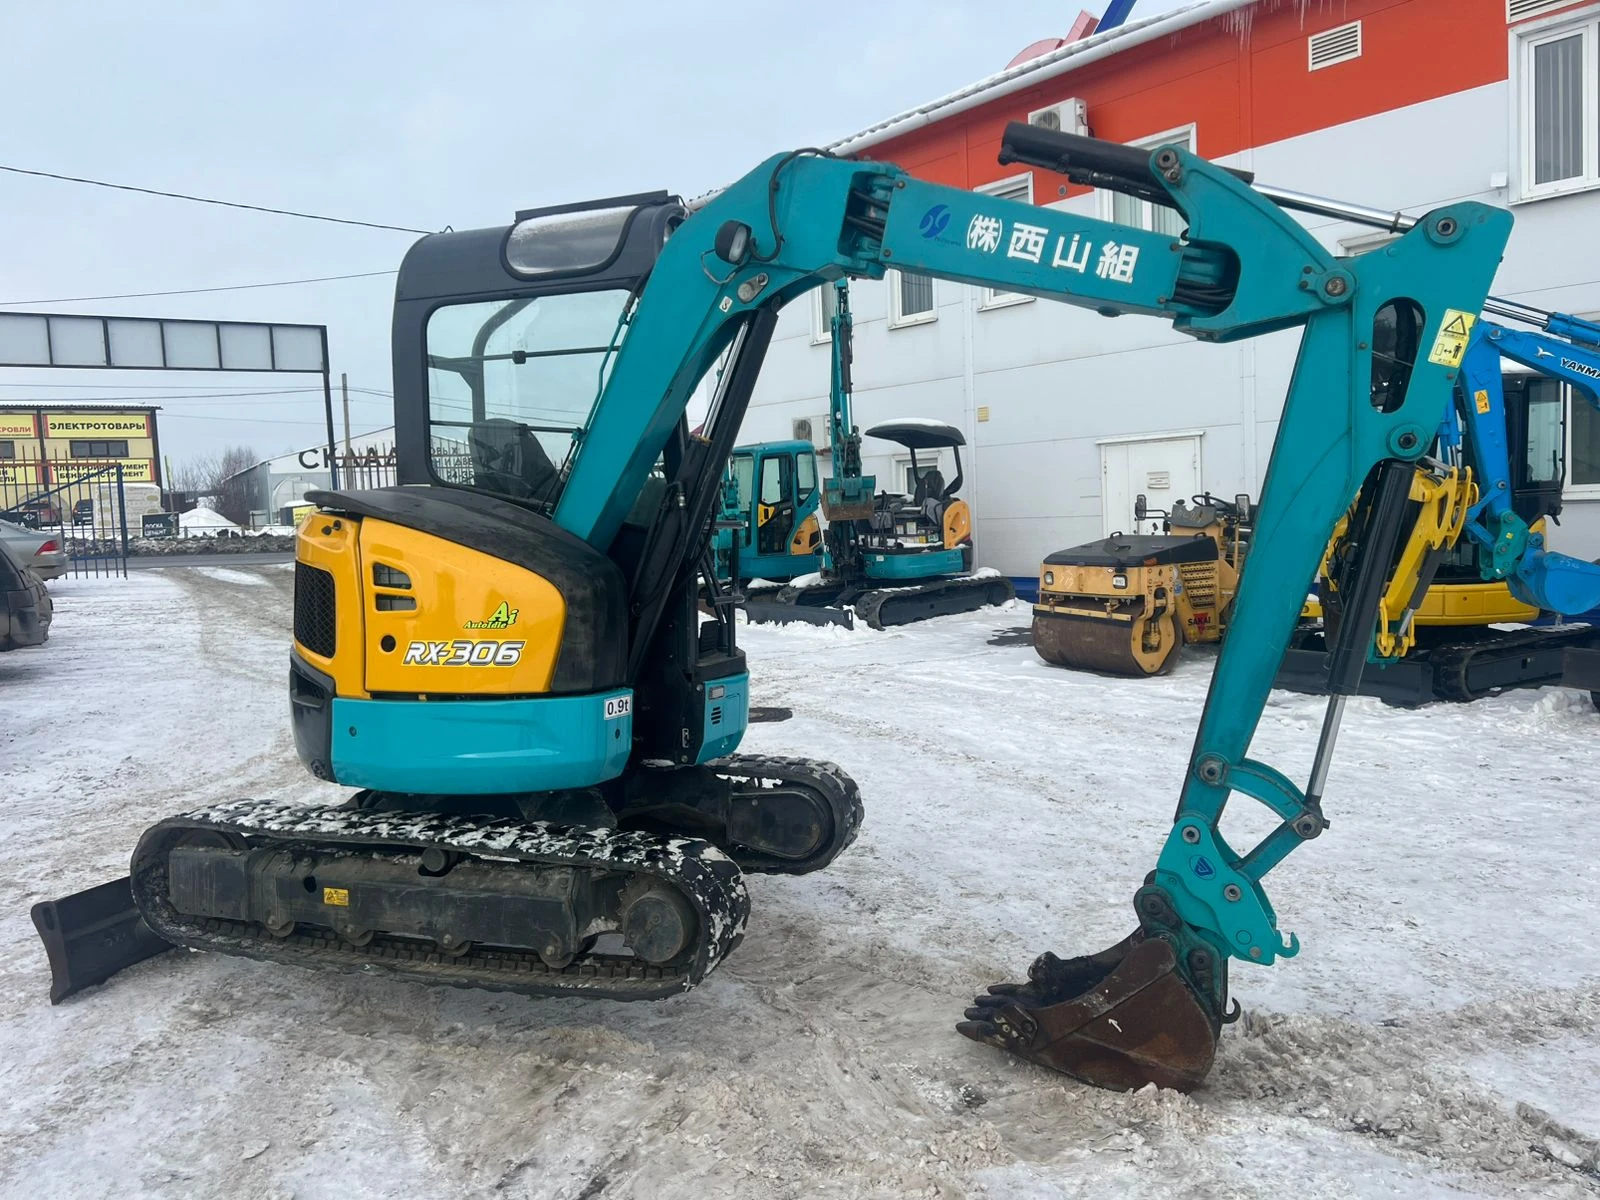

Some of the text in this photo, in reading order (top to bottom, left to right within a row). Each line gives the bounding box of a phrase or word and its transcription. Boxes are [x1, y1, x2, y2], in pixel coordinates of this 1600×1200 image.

[49, 422, 145, 430] ЭЛЕКТРОТОВАРЫ
[463, 620, 507, 629] AutoIdle
[403, 640, 526, 666] RX-306
[607, 699, 629, 716] 0.9t
